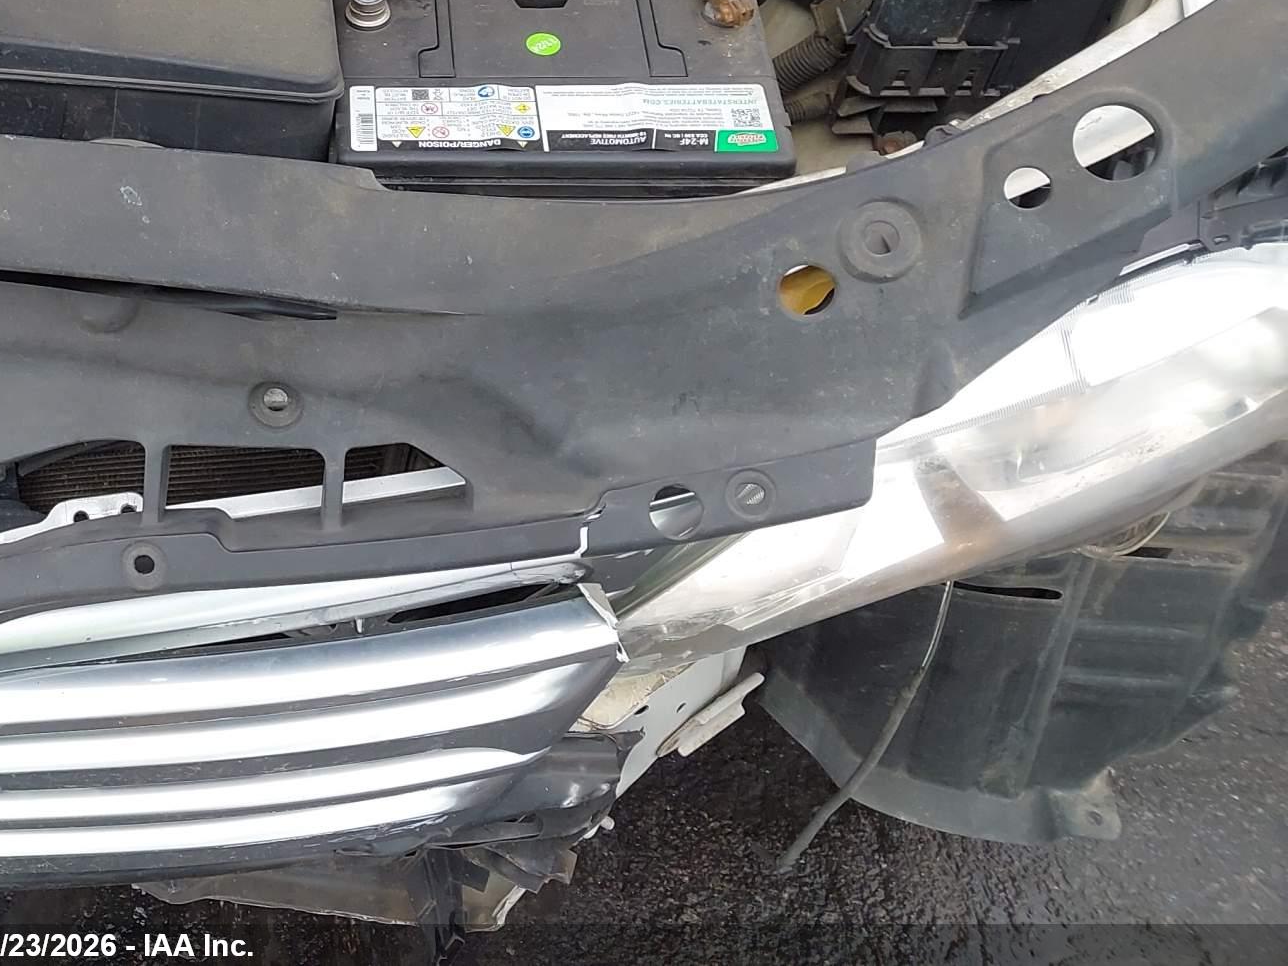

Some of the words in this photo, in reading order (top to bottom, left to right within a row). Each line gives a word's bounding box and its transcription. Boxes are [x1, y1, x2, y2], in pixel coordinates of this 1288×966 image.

[418, 138, 502, 149] DANGER/POISON
[589, 136, 647, 145] AUTOMOTIVE
[679, 137, 709, 146] M-24F
